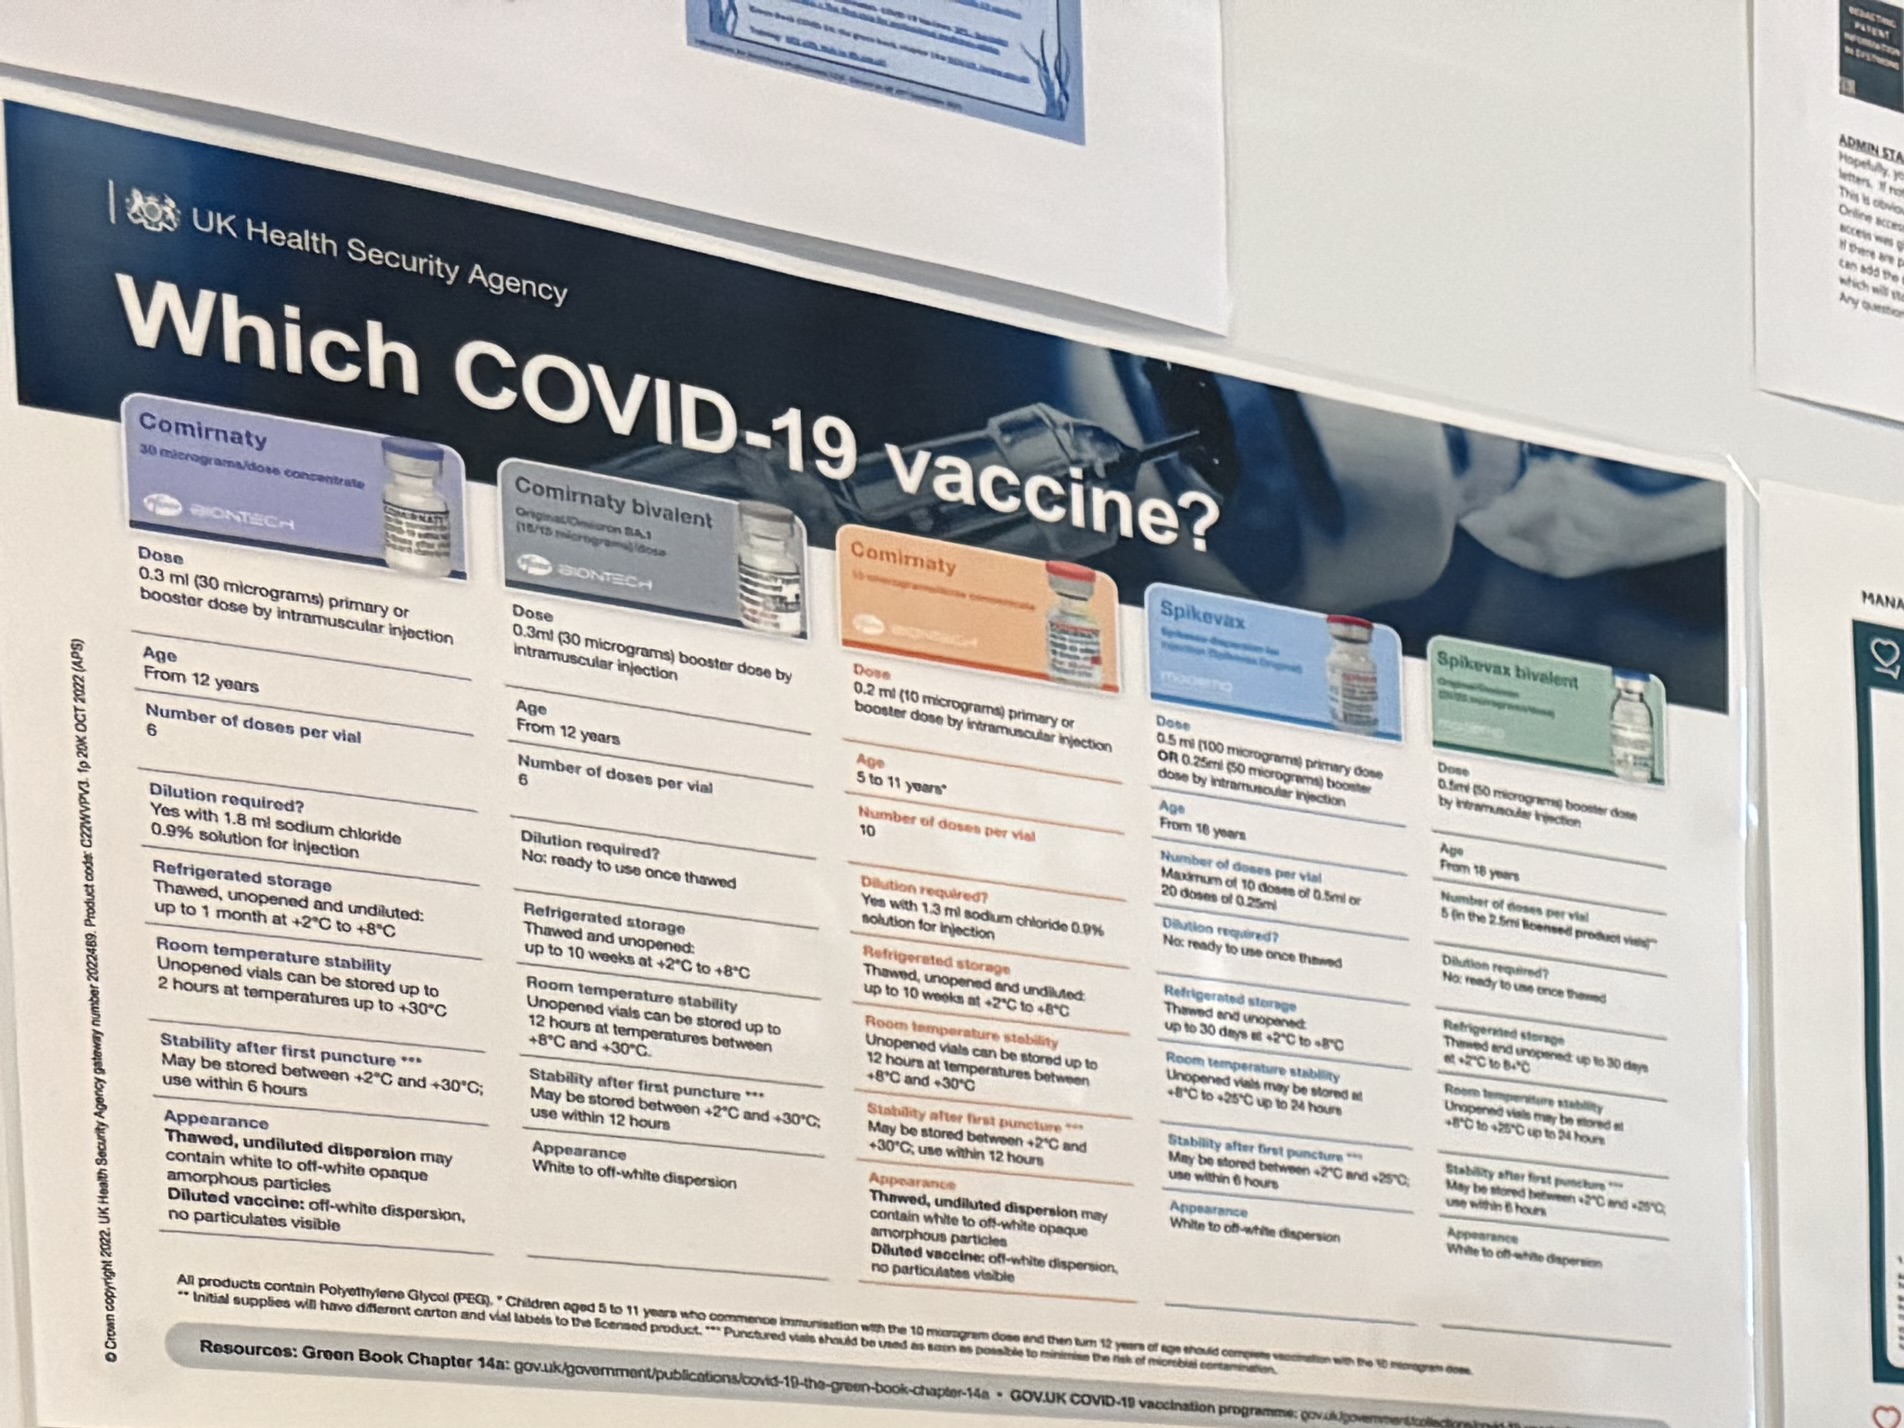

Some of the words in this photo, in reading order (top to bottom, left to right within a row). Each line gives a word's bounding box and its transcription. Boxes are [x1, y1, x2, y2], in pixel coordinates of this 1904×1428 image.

[193, 208, 237, 238] UK
[247, 218, 337, 257] Health
[347, 238, 459, 285] Security
[468, 263, 567, 307] Agency
[115, 272, 419, 395] Which
[454, 340, 858, 479] COVID-19
[884, 442, 1220, 551] vaccine?
[139, 412, 266, 451] Comirnaty
[515, 476, 625, 514] Comirnaty
[632, 498, 712, 529] bivalent
[138, 545, 183, 565] Dose
[851, 541, 956, 577] Comirnaty
[139, 566, 164, 582] 0.3
[169, 573, 188, 586] ml
[194, 574, 219, 590] (30
[223, 581, 324, 608] micrograms)
[329, 597, 388, 618] primary
[393, 606, 409, 618] or
[140, 586, 203, 607] booster
[207, 597, 248, 614] dose
[252, 602, 272, 620] by
[277, 607, 384, 633] intramuscular
[389, 623, 453, 645] injection
[512, 603, 553, 622] Dose
[1160, 599, 1245, 629] Spikevax
[143, 645, 177, 664] Age
[1437, 650, 1511, 677] Spikevax
[1515, 665, 1578, 690] bivalent
[144, 665, 186, 683] From
[192, 672, 210, 686] 12
[215, 678, 259, 693] years
[853, 662, 891, 680] Dose
[146, 702, 216, 723] Number
[221, 714, 238, 727] of
[243, 716, 294, 734] doses
[300, 726, 328, 738] per
[332, 729, 361, 743] vial
[515, 699, 547, 716] Age
[1156, 714, 1190, 731] Dose
[146, 722, 157, 736] 6
[517, 717, 555, 736] From
[560, 725, 576, 739] 12
[580, 730, 620, 745] years
[518, 753, 581, 774] Number
[586, 765, 601, 777] of
[606, 768, 652, 785] doses
[657, 777, 683, 789] per
[687, 780, 712, 793] vial
[856, 753, 885, 769] Age
[1437, 761, 1469, 777] Dose
[518, 773, 528, 786] 6
[149, 782, 216, 803] Dilution
[222, 794, 304, 813] required?
[1158, 799, 1185, 815] Age
[150, 801, 180, 818] Yes
[184, 807, 218, 822] with
[224, 811, 246, 826] 1.8
[251, 816, 270, 828] ml
[275, 820, 334, 836] sodium
[338, 826, 401, 844] chloride
[859, 823, 876, 837] 10
[151, 821, 193, 839] 0.9%
[199, 830, 262, 847] solution
[266, 835, 288, 850] for
[293, 838, 359, 858] injection
[521, 829, 581, 849] Dilution
[586, 841, 660, 860] required?
[1439, 842, 1463, 858] Age
[153, 859, 261, 884] Refrigerated
[267, 874, 332, 893] storage
[521, 848, 547, 863] No:
[551, 855, 592, 872] ready
[596, 859, 611, 872] to
[615, 864, 641, 876] use
[645, 868, 681, 881] once
[684, 871, 736, 889] thawed
[153, 879, 222, 901] Thawed,
[227, 890, 308, 909] unopened
[313, 899, 343, 912] and
[348, 904, 424, 922] undiluted:
[860, 875, 917, 894] Dilution
[919, 885, 988, 903] required?
[524, 902, 622, 926] Refrigerated
[627, 917, 685, 936] storage
[1162, 916, 1213, 934] Dilution
[1217, 927, 1279, 943] required?
[156, 936, 208, 954] Room
[213, 943, 319, 966] temperature
[324, 956, 391, 975] stability
[93, 1076, 107, 1118] Agency
[164, 1109, 269, 1129] Appearance
[94, 1119, 109, 1165] Security
[532, 1140, 626, 1160] Appearance
[96, 1168, 109, 1203] Health
[868, 1172, 956, 1190] Appearance
[97, 1206, 110, 1223] UK
[1170, 1200, 1248, 1217] Appearance
[98, 1227, 112, 1257] 2022.
[101, 1259, 116, 1311] copyright
[104, 1313, 117, 1349] Crown
[200, 1339, 297, 1358] Resources:
[302, 1345, 353, 1361] Green
[358, 1348, 403, 1364] Book
[407, 1351, 473, 1369] Chapter
[478, 1356, 509, 1370] 14a:
